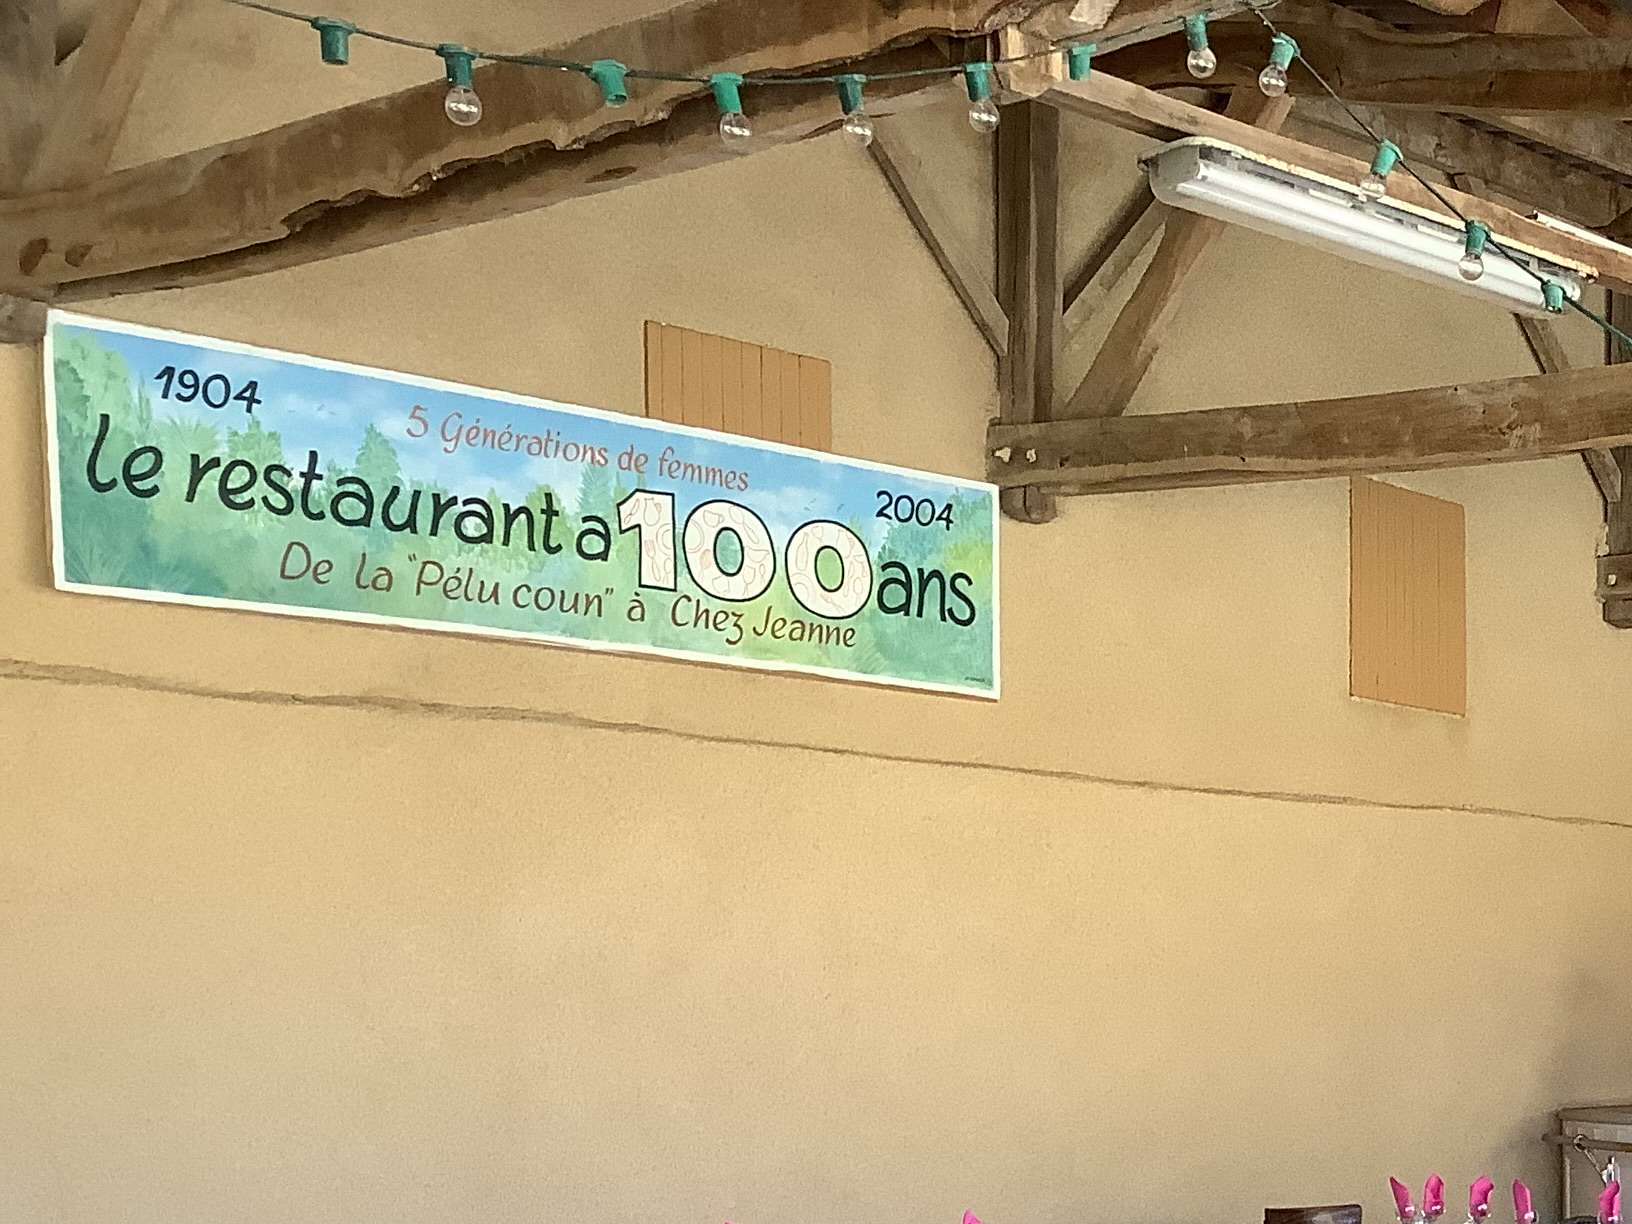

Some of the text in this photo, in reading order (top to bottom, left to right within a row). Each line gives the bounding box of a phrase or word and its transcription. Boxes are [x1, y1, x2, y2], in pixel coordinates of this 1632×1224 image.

[154, 366, 262, 413] 1904
[406, 405, 749, 491] 5 Générations de femmes
[185, 450, 563, 555] restaurant
[576, 516, 611, 562] a
[617, 488, 873, 620] 100
[877, 560, 976, 627] ans
[876, 491, 954, 531] 2004
[280, 542, 333, 584] De
[356, 553, 393, 592] la
[627, 592, 645, 622] à
[671, 594, 744, 645] Chez
[752, 606, 857, 648] Jeanne
